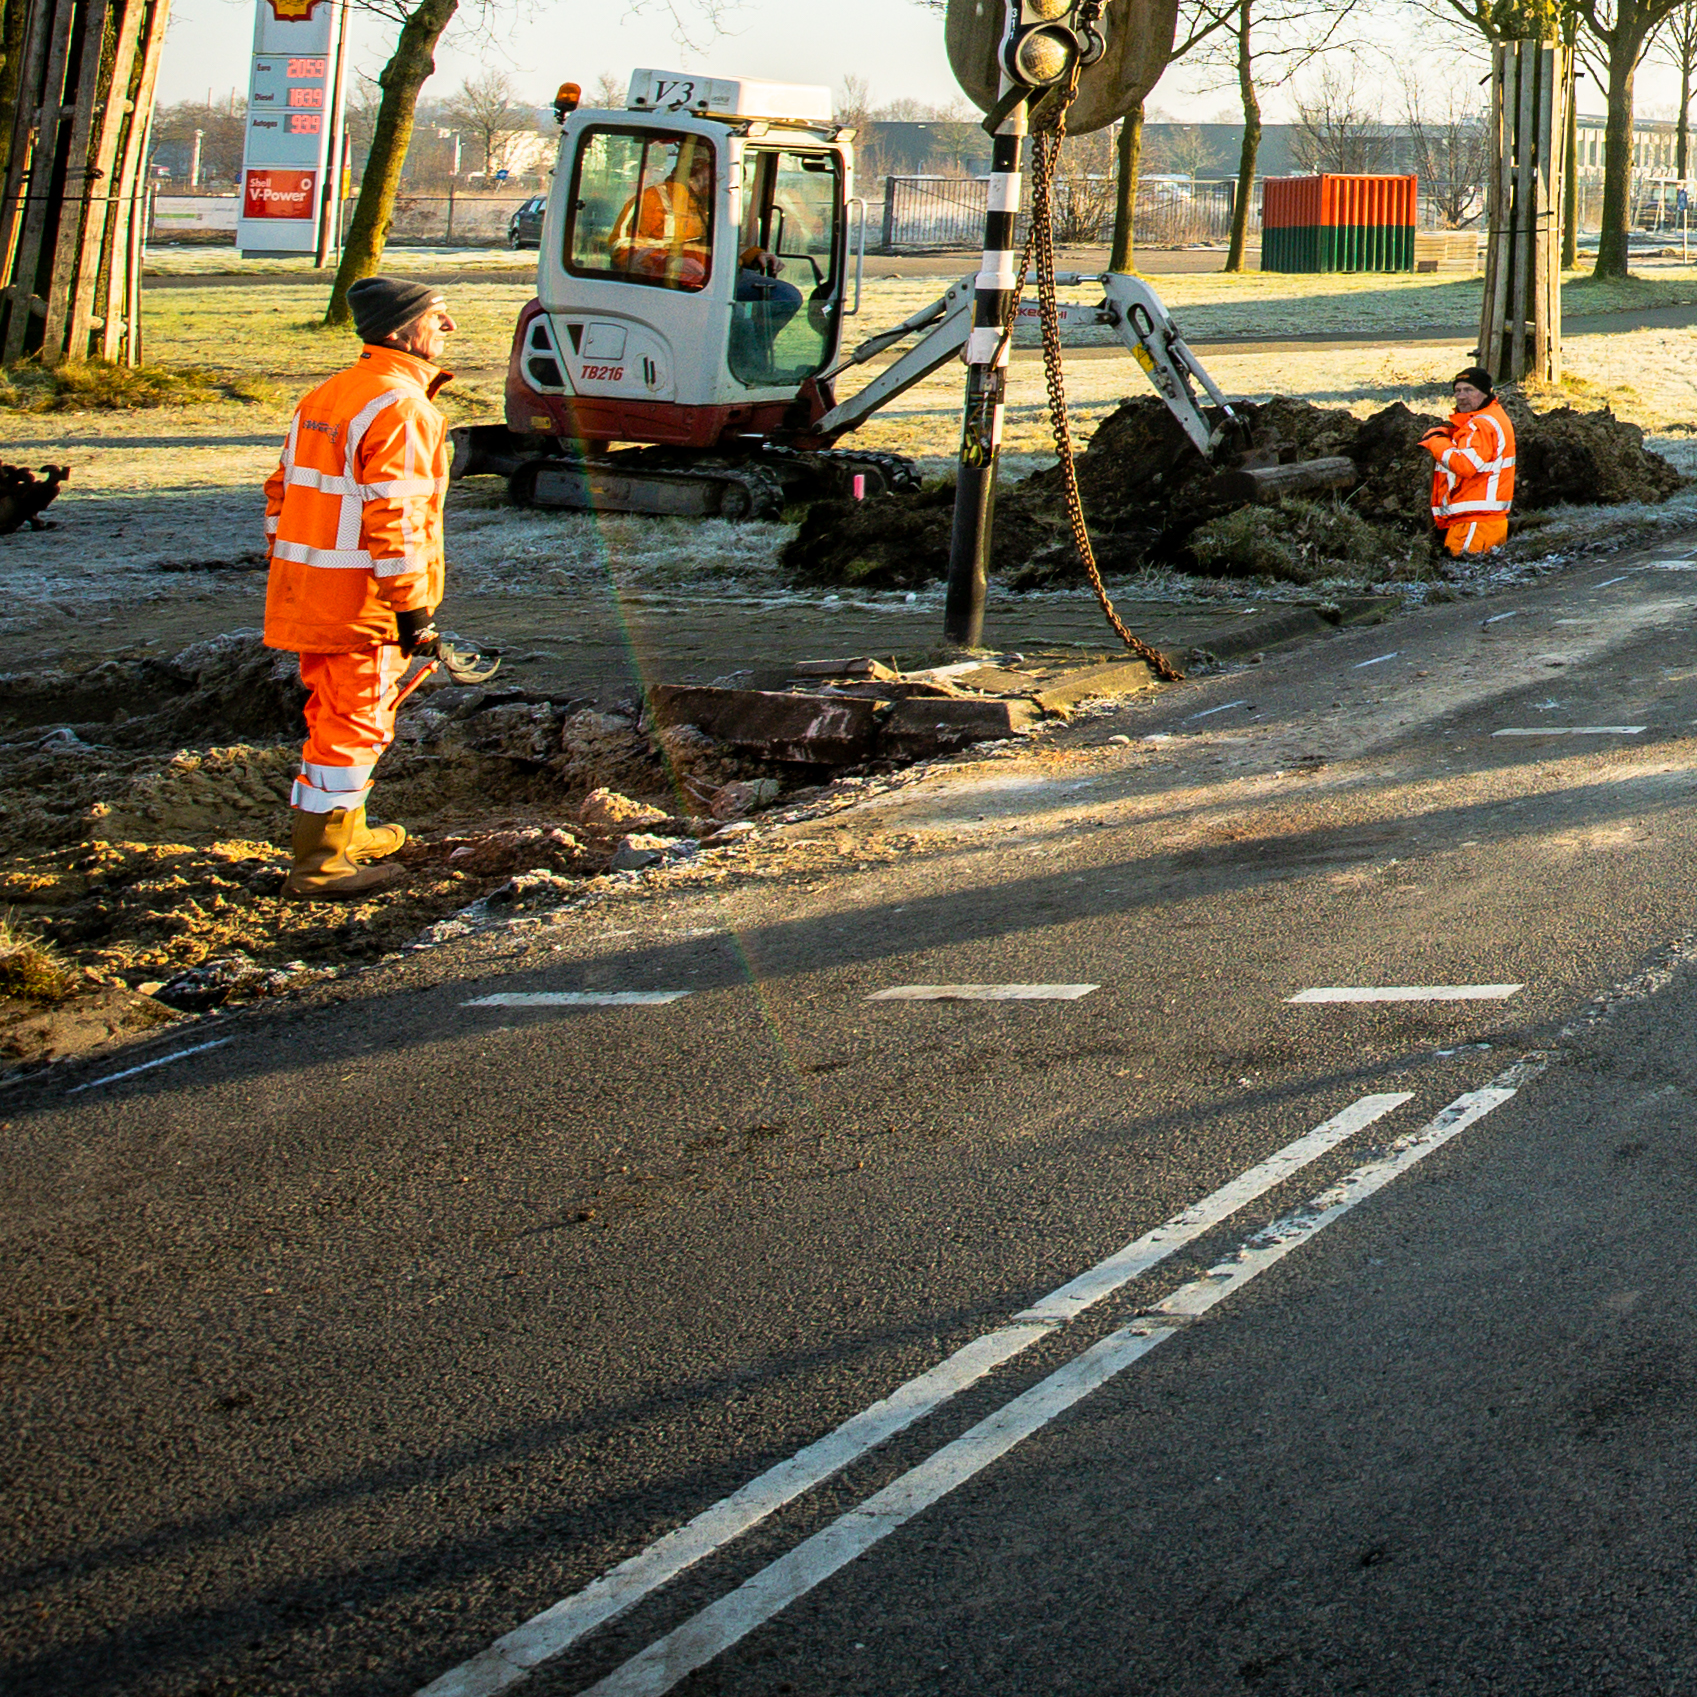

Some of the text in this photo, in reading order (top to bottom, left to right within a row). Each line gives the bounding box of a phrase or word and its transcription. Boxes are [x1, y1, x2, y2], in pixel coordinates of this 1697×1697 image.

[254, 93, 275, 101] Diesel
[252, 119, 278, 130] Autogas
[249, 177, 272, 188] Shell
[249, 188, 307, 202] V-Power
[580, 365, 625, 381] TB216
